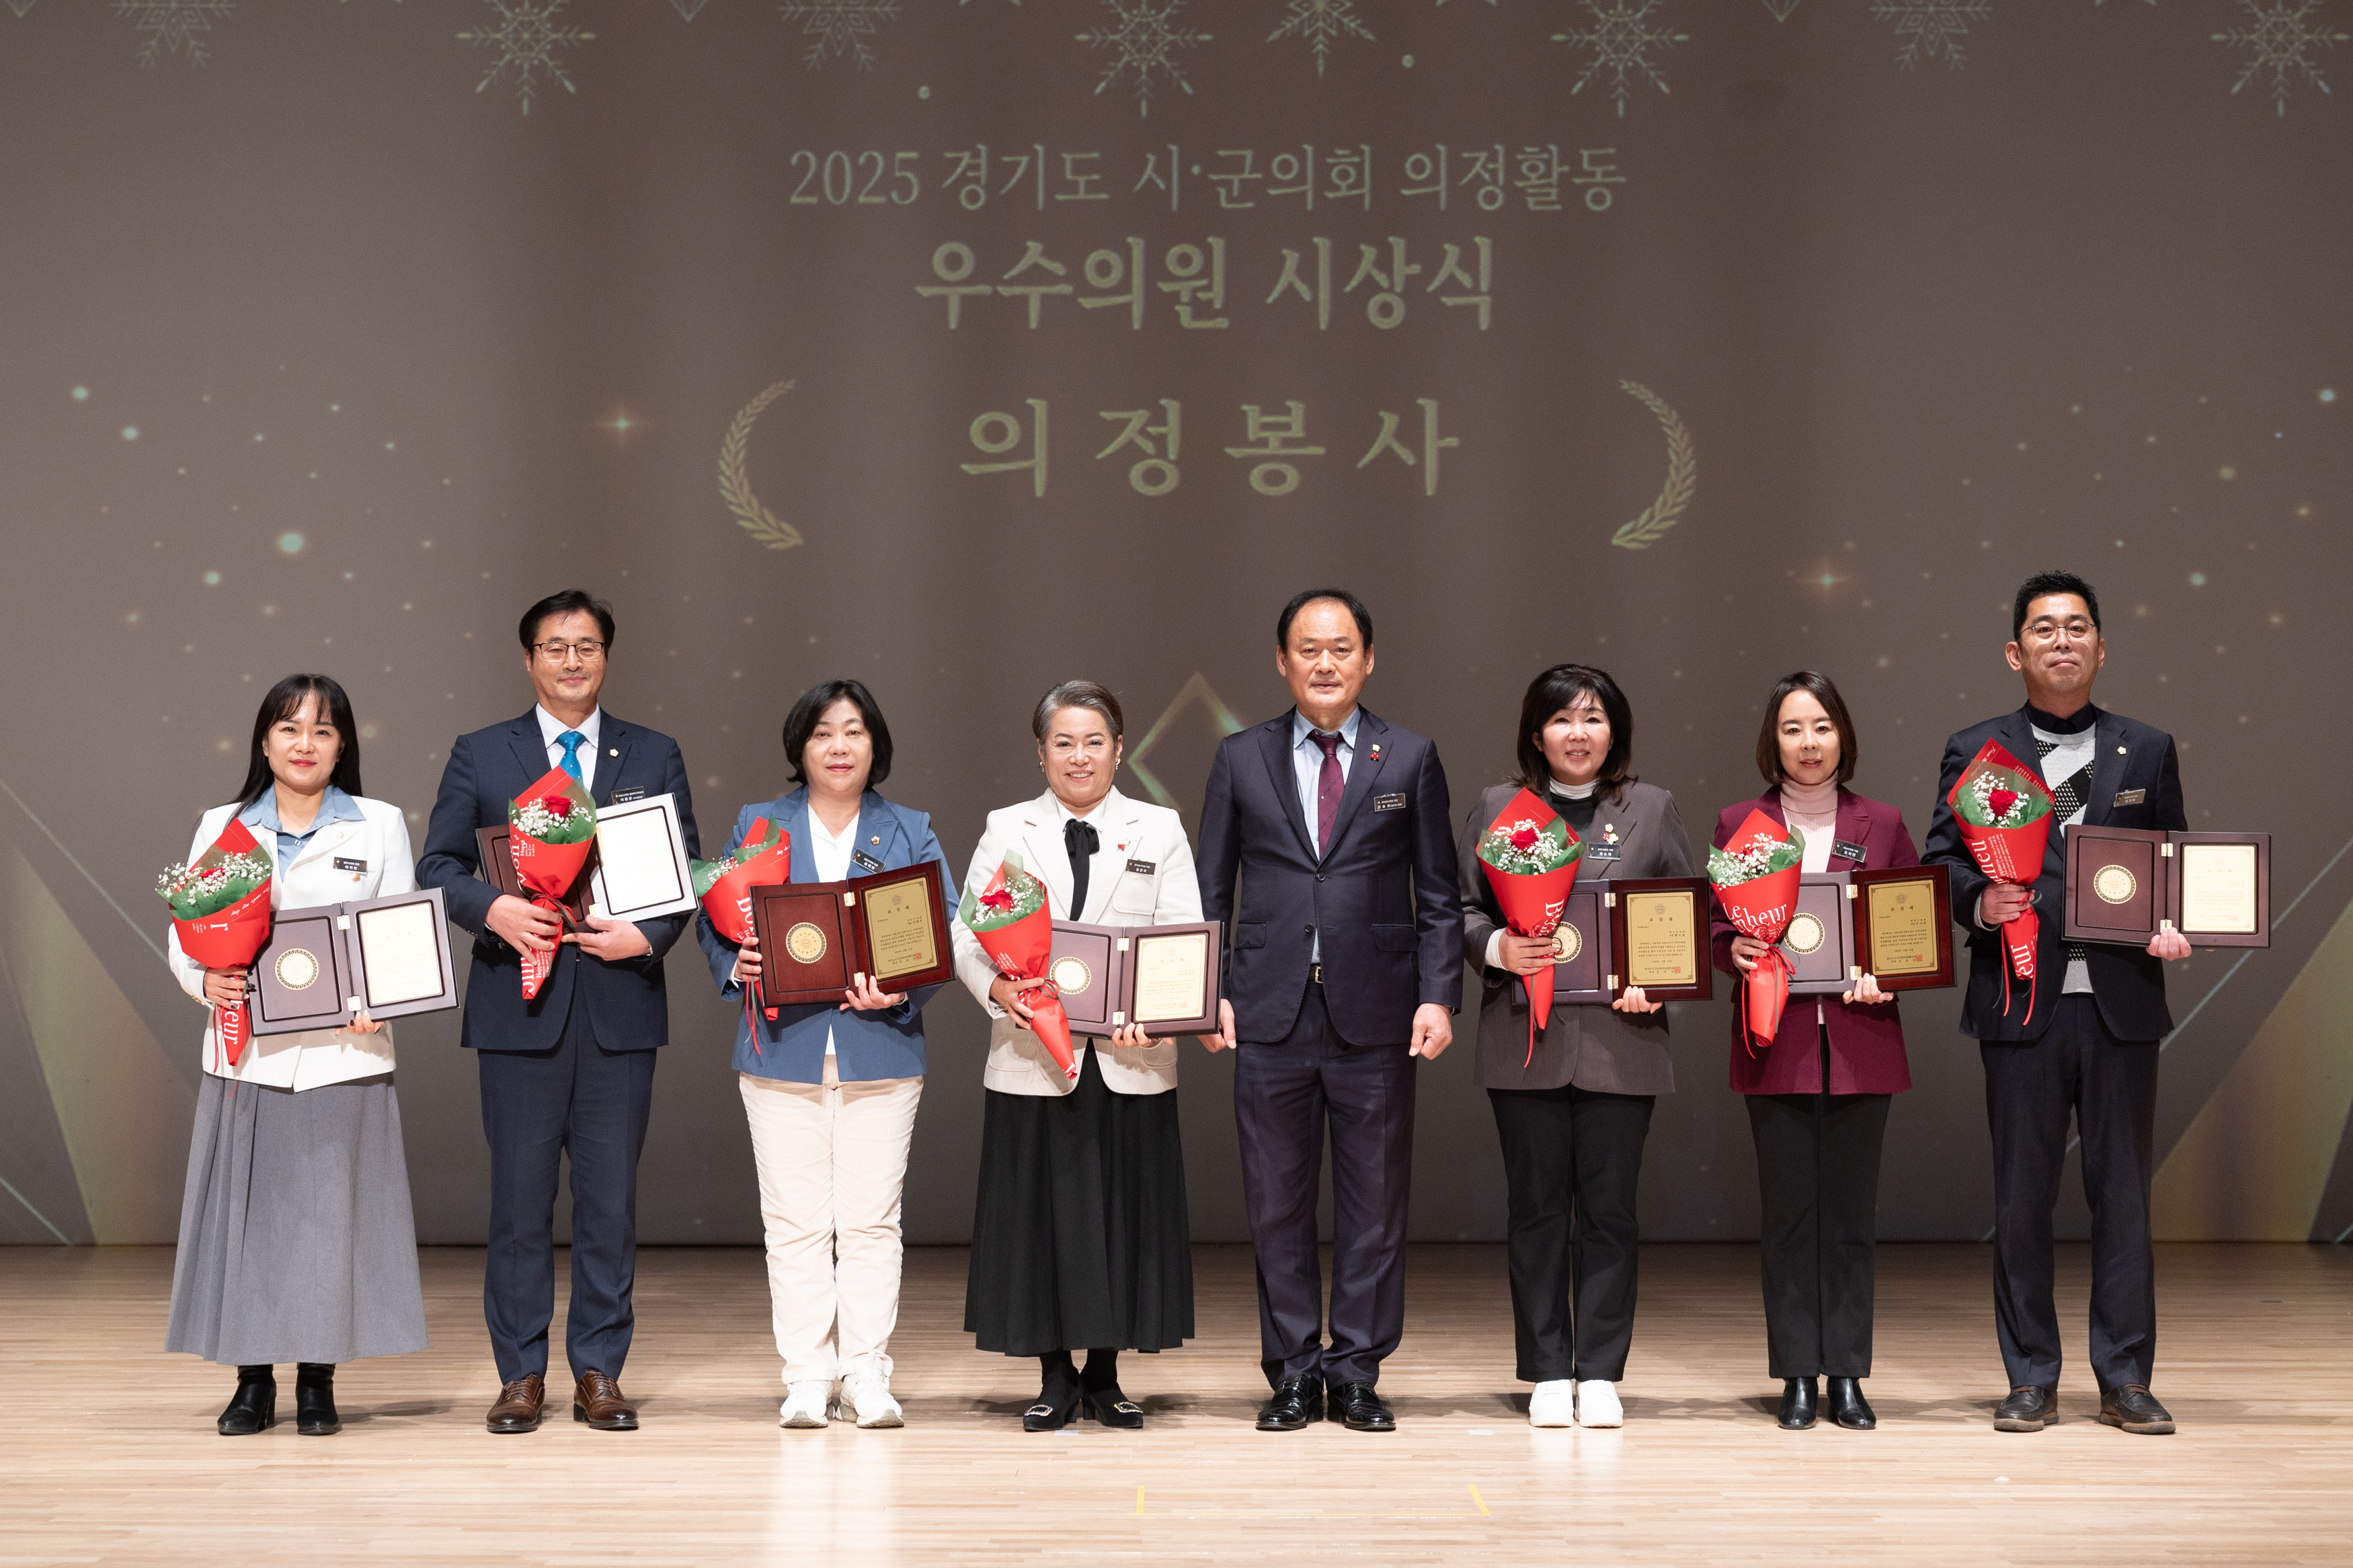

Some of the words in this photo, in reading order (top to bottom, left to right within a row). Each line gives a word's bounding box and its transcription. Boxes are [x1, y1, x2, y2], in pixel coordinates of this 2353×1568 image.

[788, 151, 921, 206] 2025
[942, 146, 1111, 211] 경기도
[1133, 145, 1373, 211] 시·군의회
[1400, 145, 1627, 211] 의정활동
[916, 237, 1230, 330] 우수의원
[1267, 237, 1492, 330] 시상식
